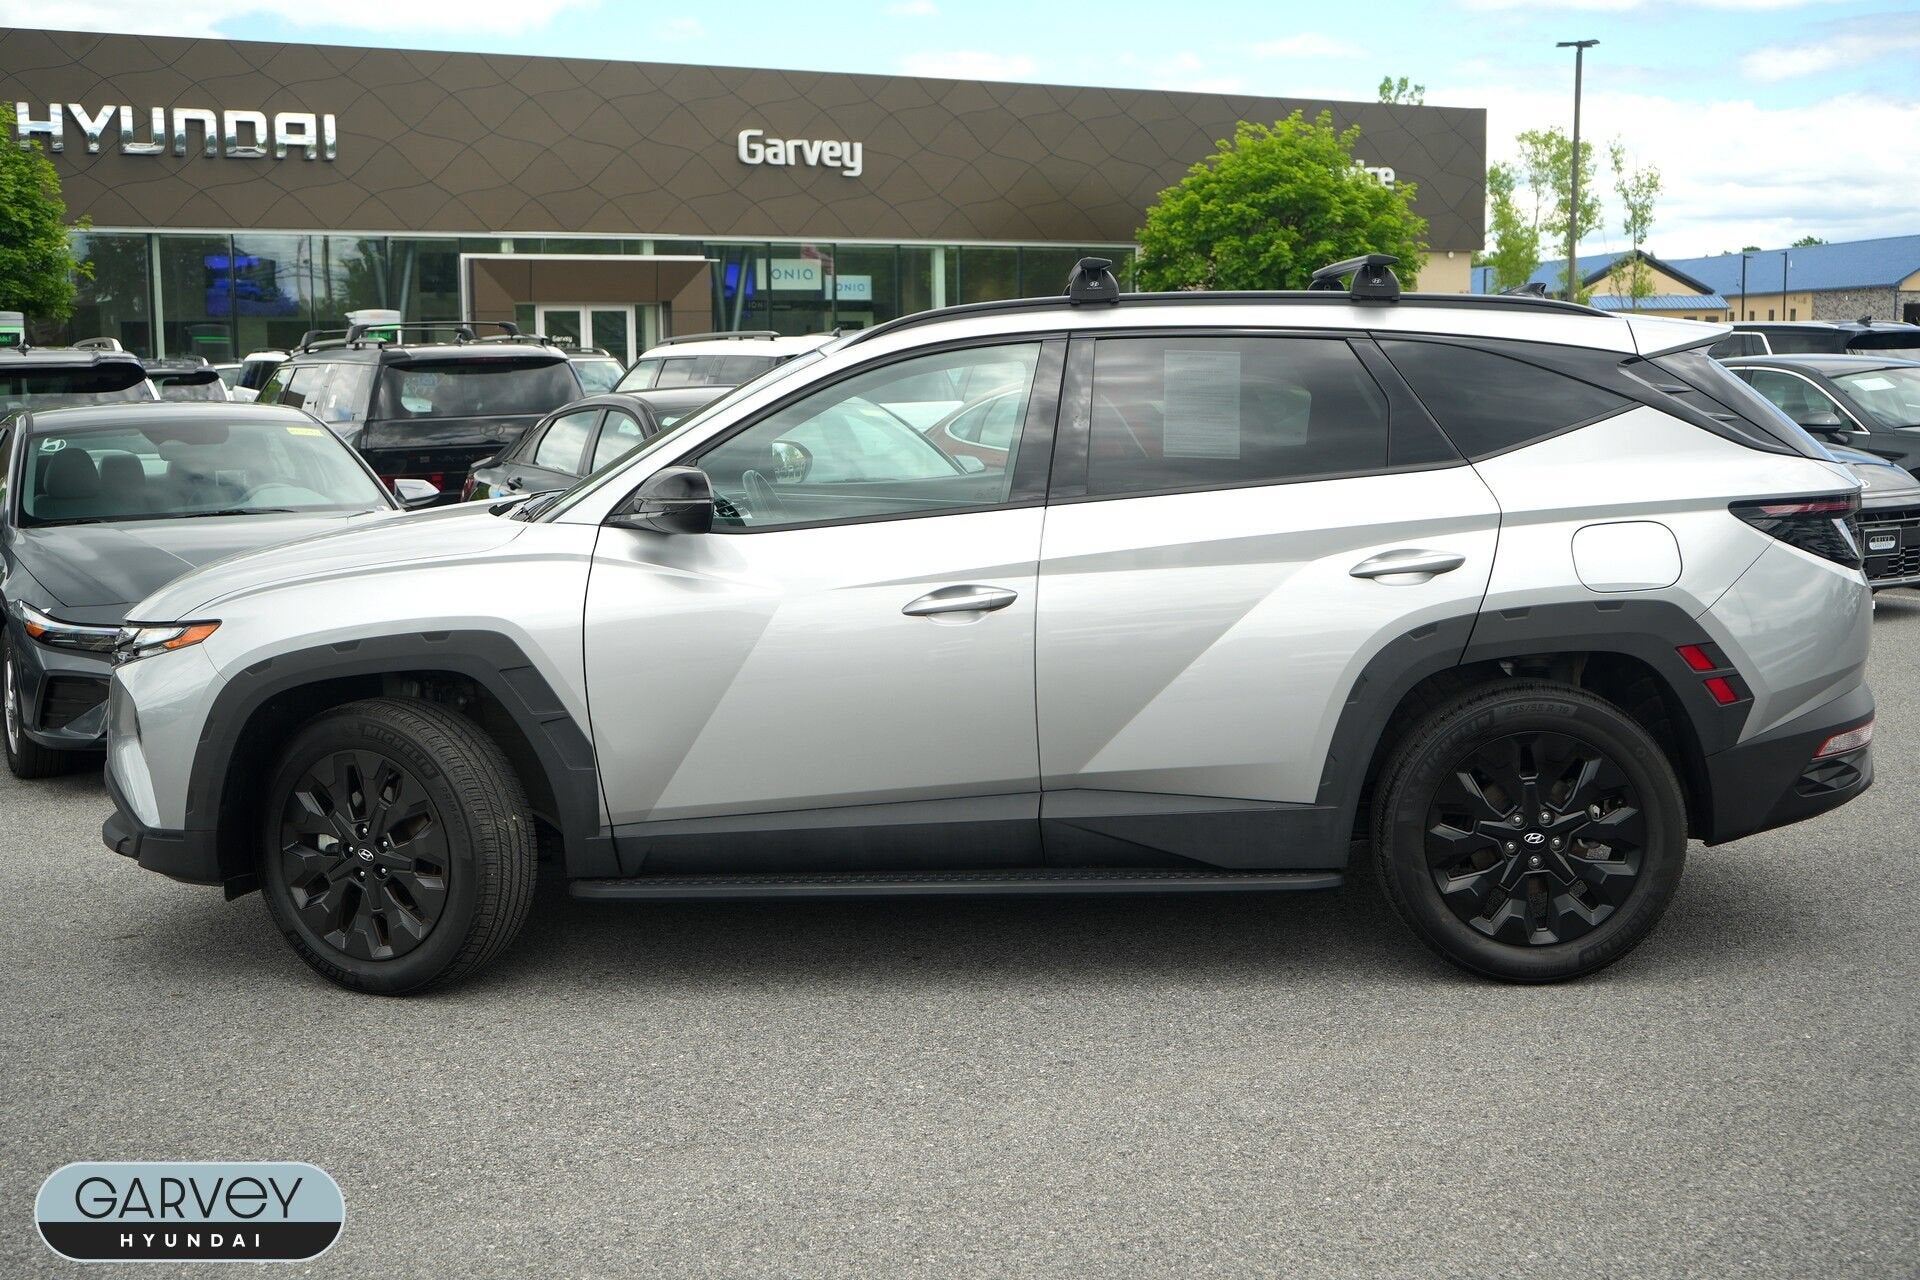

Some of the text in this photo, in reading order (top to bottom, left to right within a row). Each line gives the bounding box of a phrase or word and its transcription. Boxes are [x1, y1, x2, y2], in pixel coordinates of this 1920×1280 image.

[16, 102, 337, 160] HYUNDAI
[738, 129, 863, 177] Garvey
[771, 268, 814, 280] ONIQ
[362, 725, 440, 780] MICHELIN
